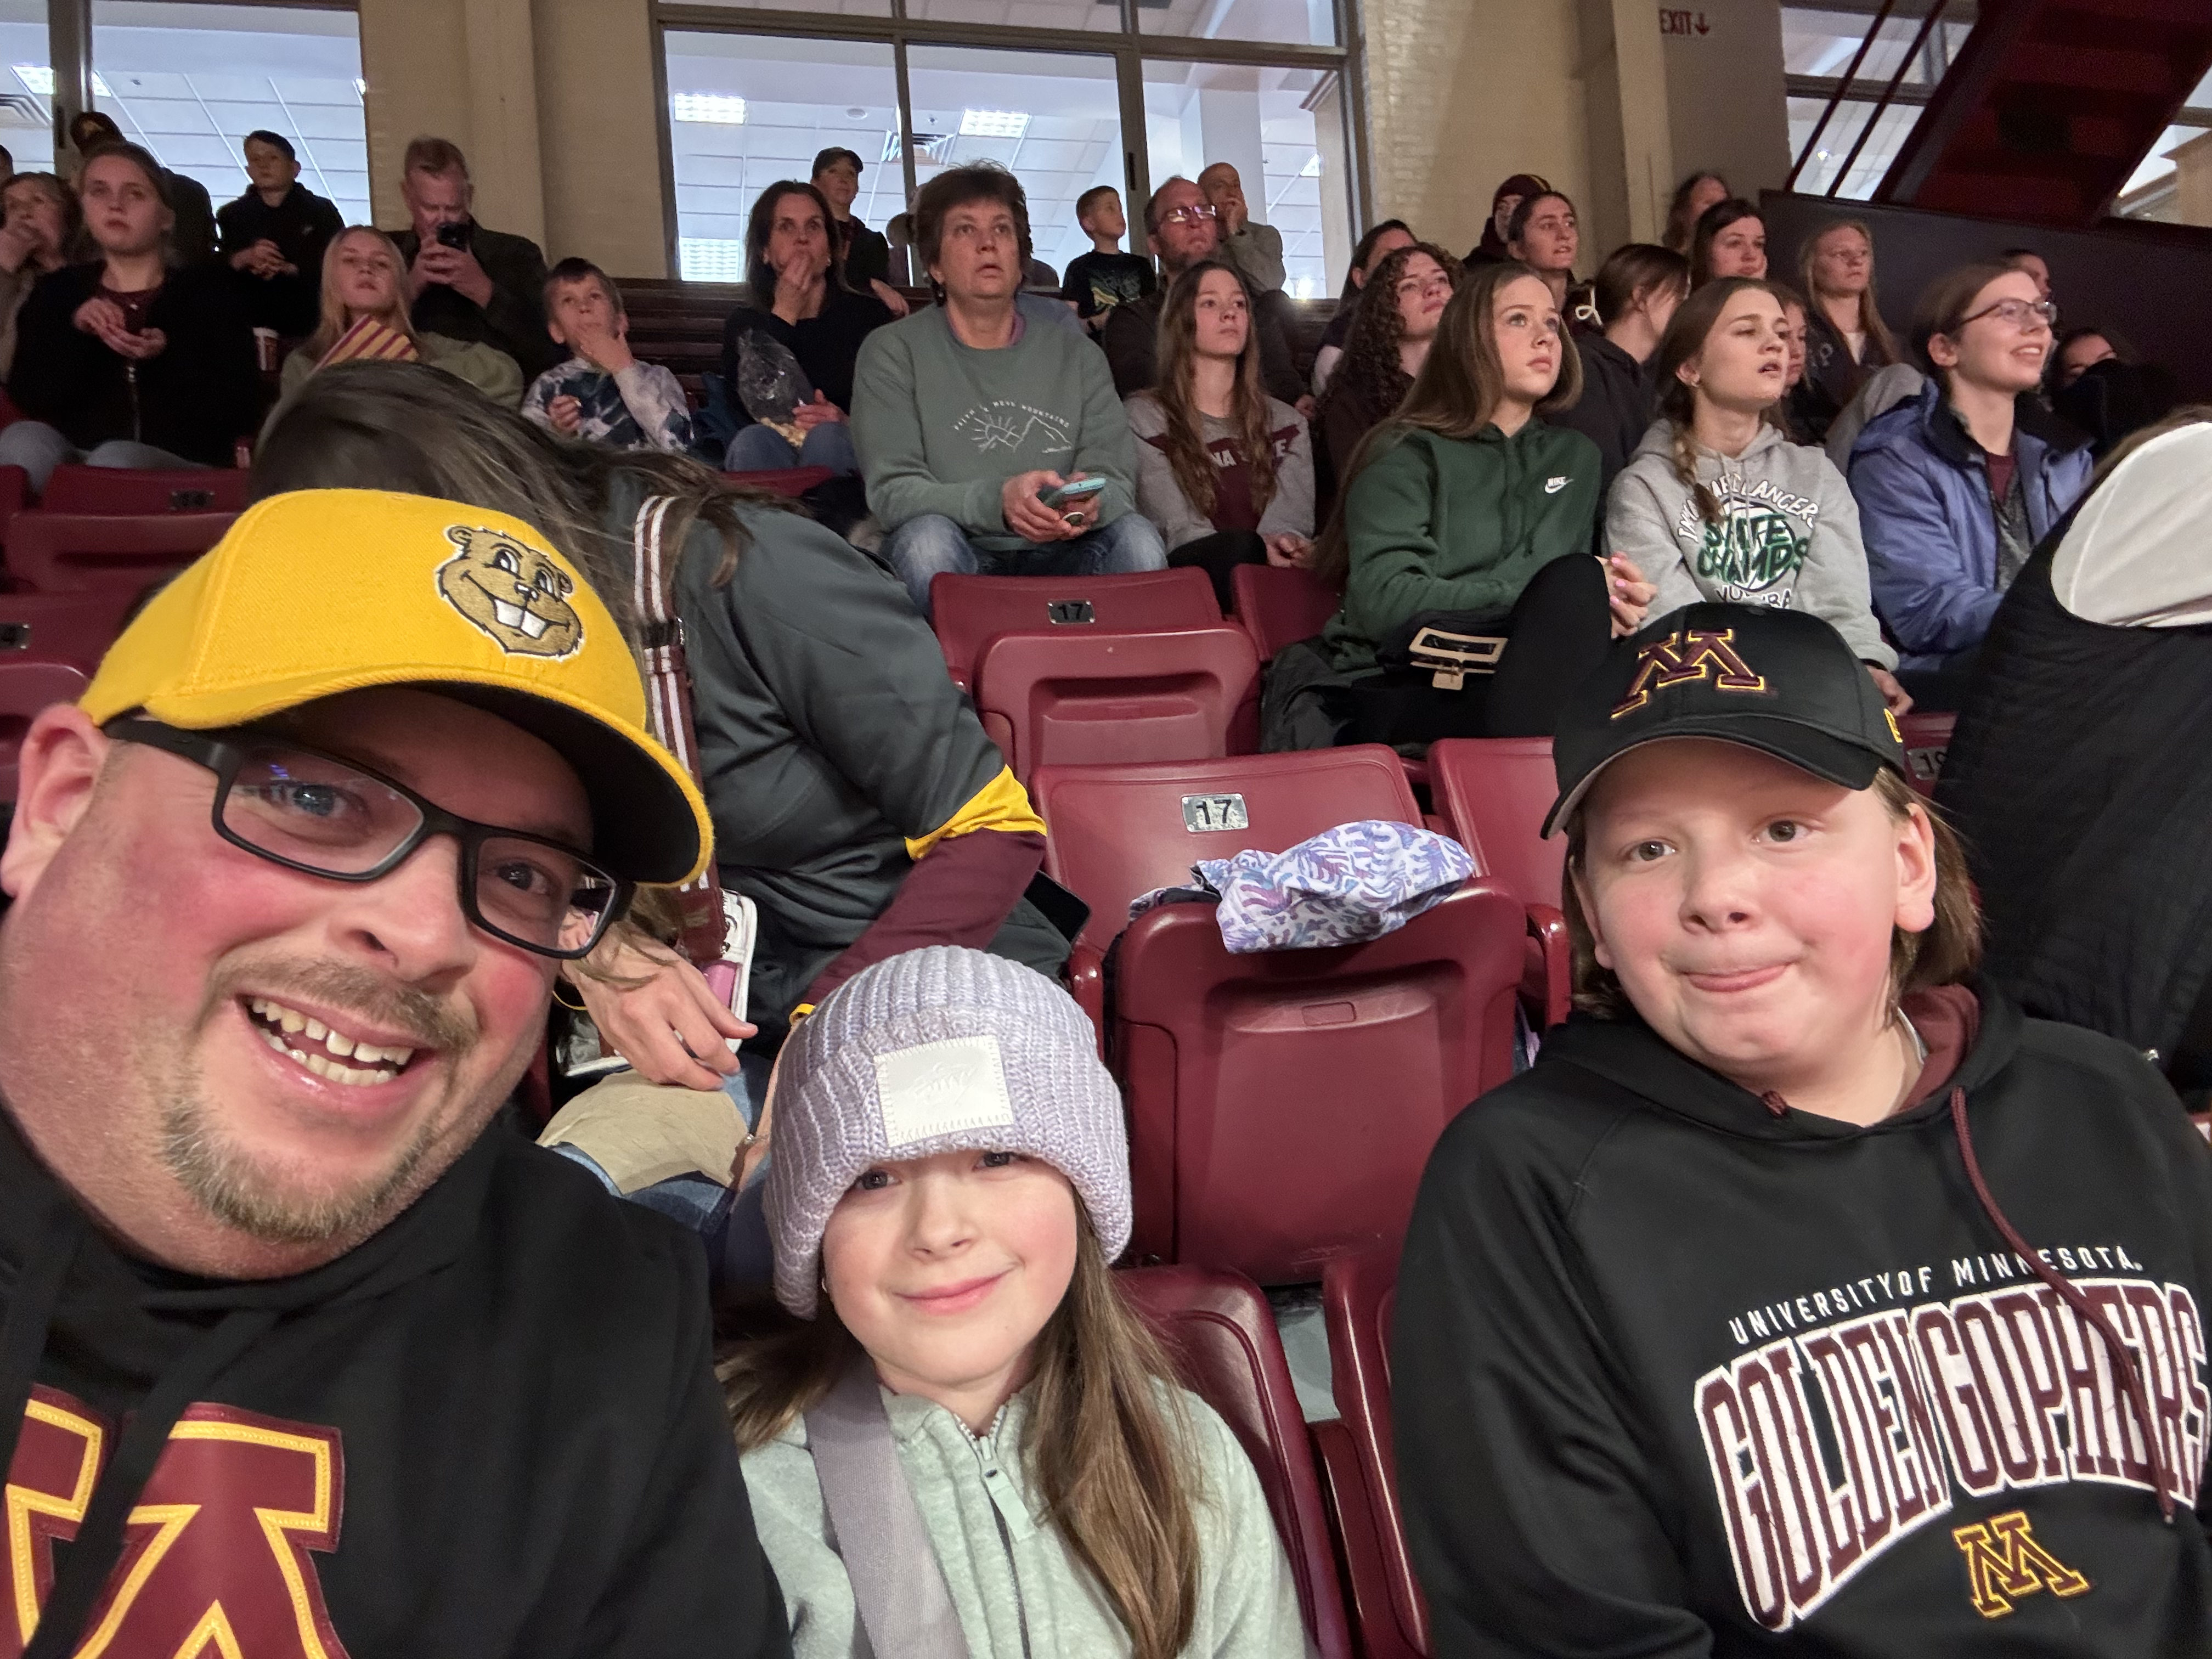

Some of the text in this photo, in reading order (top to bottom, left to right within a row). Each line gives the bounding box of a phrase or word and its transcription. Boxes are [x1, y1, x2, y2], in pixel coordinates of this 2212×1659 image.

[1660, 9, 1691, 34] EXIT
[1548, 476, 1566, 487] NIKE
[1058, 603, 1083, 620] 17
[1610, 628, 1765, 720] M
[1195, 799, 1232, 825] 17
[1728, 1245, 2136, 1345] UNIVERSITY OF MINNESOTA
[1694, 1277, 2211, 1633] GOLDEN GOPHERS
[1951, 1509, 2091, 1620] M
